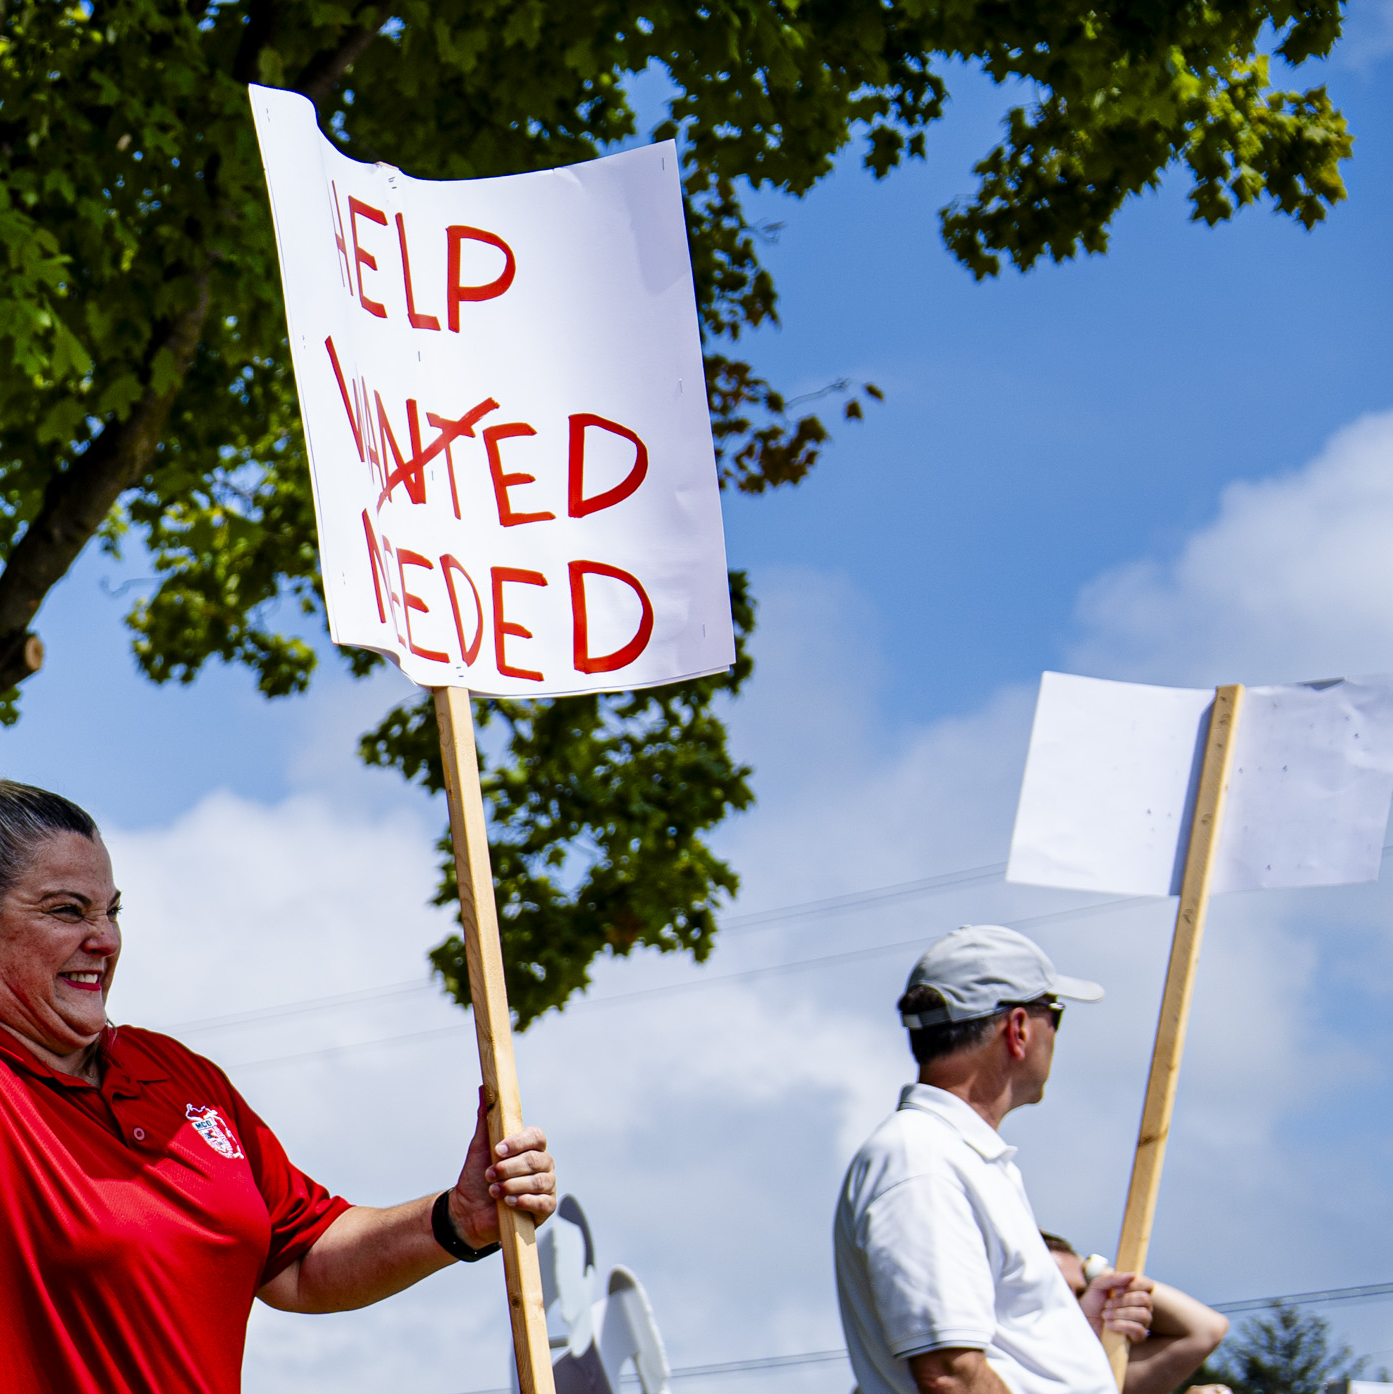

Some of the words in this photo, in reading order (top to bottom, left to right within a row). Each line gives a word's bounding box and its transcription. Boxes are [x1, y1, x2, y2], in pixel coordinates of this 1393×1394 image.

[331, 180, 516, 333] HELP
[325, 336, 648, 528] WANTED
[361, 508, 654, 682] NEEDED
